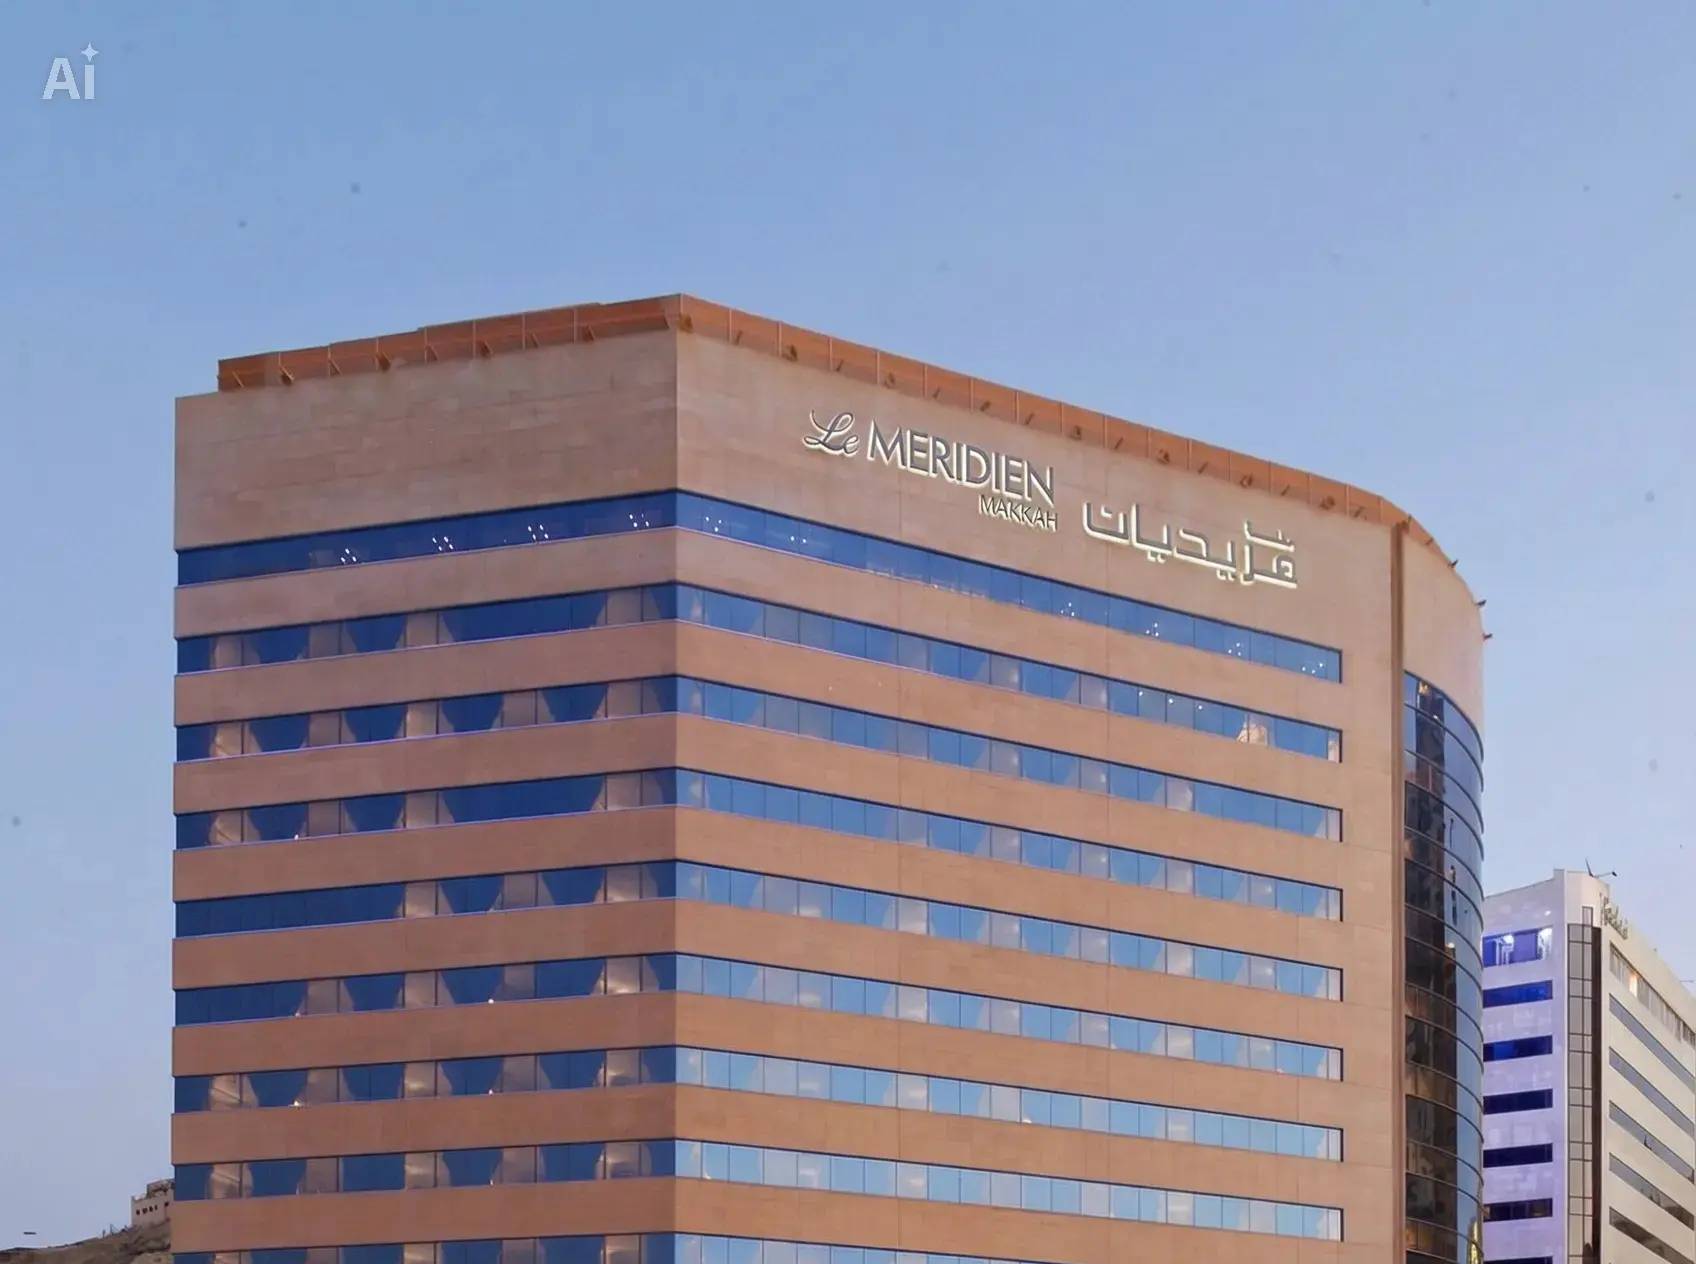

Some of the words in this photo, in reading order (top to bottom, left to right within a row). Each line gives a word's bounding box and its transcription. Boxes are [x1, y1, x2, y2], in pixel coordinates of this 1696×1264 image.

[802, 409, 860, 456] Le
[866, 417, 1055, 508] MERIDIEN
[978, 494, 1058, 533] MAKKAH
